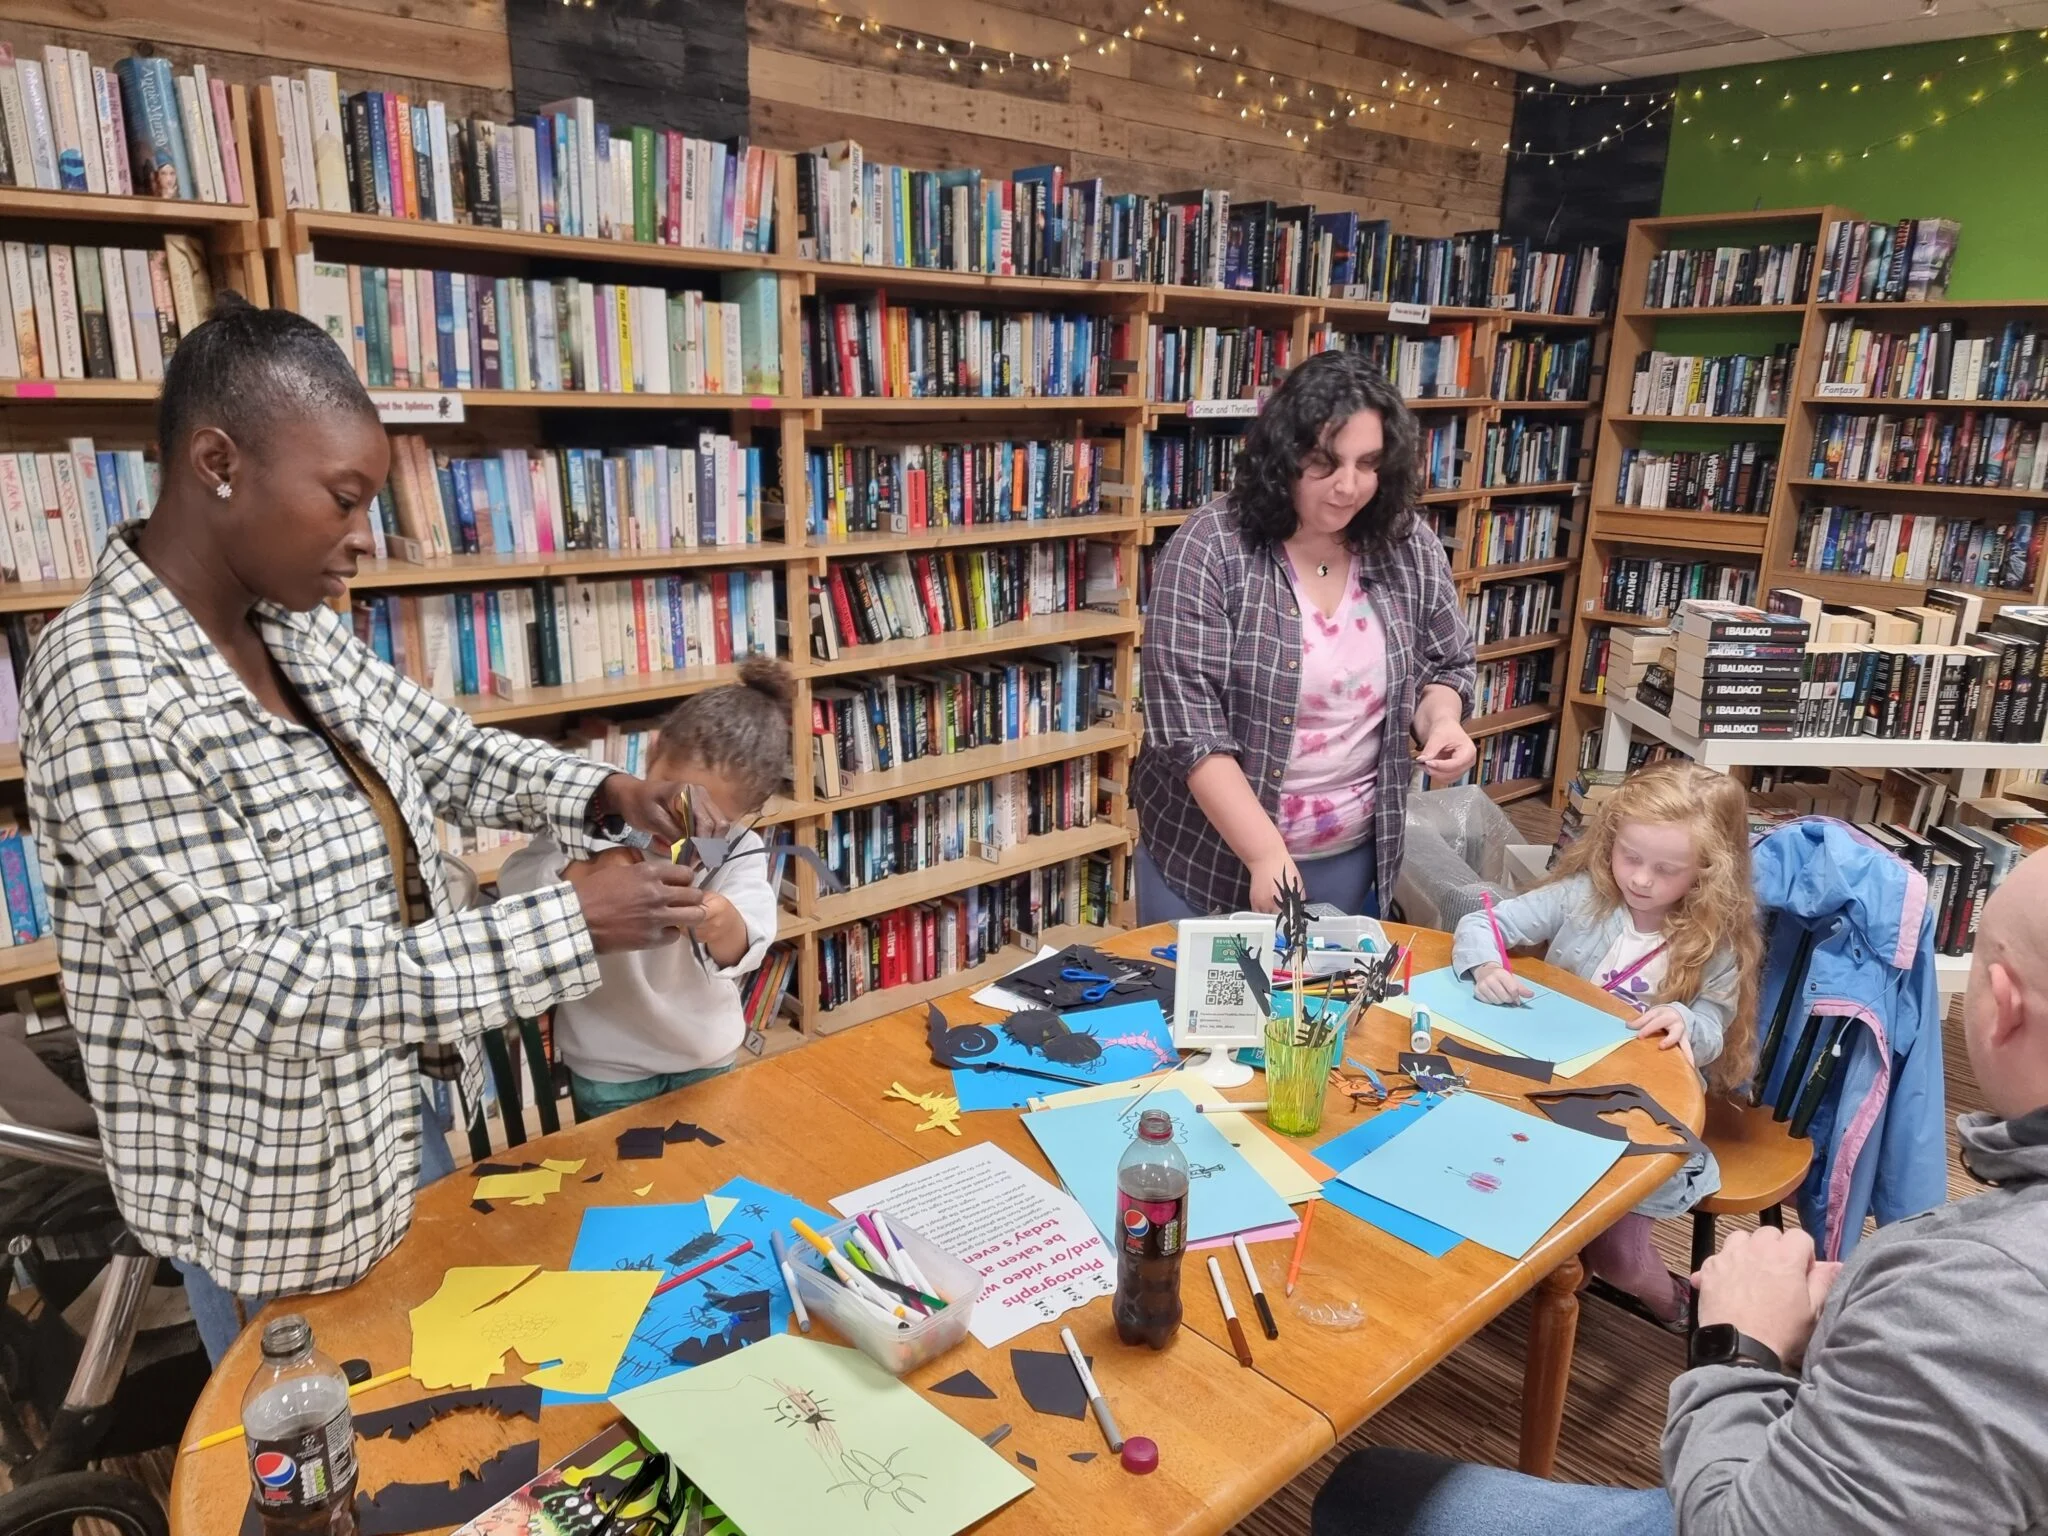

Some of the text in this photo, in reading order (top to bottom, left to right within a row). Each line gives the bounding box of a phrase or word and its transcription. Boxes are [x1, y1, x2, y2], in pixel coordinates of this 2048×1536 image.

[1117, 263, 1125, 276] B
[1822, 384, 1859, 395] Fantasy
[405, 402, 434, 412] Splinters
[1195, 404, 1257, 414] Crime and Thrillers
[895, 517, 903, 530] C
[856, 578, 871, 608] THE TWO
[1625, 571, 1638, 607] DRIVEN
[1658, 571, 1670, 608] RINGMAST
[1731, 627, 1771, 636] BALDACCI
[1723, 664, 1763, 673] BALDACCI
[1891, 655, 1904, 691] COLIN FORBES
[1722, 685, 1762, 694] BALDACCI
[1971, 685, 1980, 709] HEAVEN
[1721, 706, 1761, 715] BALDACCI
[2011, 698, 2022, 724] WINGS
[2017, 697, 2028, 725] BROKEN
[1719, 725, 1758, 733] BALDACCI
[841, 774, 849, 786] D
[986, 849, 993, 859] E
[1922, 849, 1931, 867] Lynda
[1973, 852, 1983, 870] Lynda
[1952, 867, 1960, 882] Lynda
[1968, 880, 1977, 898] Plante
[886, 931, 896, 957] Ellroy
[1025, 938, 1031, 947] F
[962, 1217, 1060, 1265] today's even
[976, 1232, 1065, 1277] be taken at
[1047, 1236, 1102, 1266] and/or
[1001, 1261, 1048, 1286] video
[1000, 1257, 1105, 1309] Photographs
